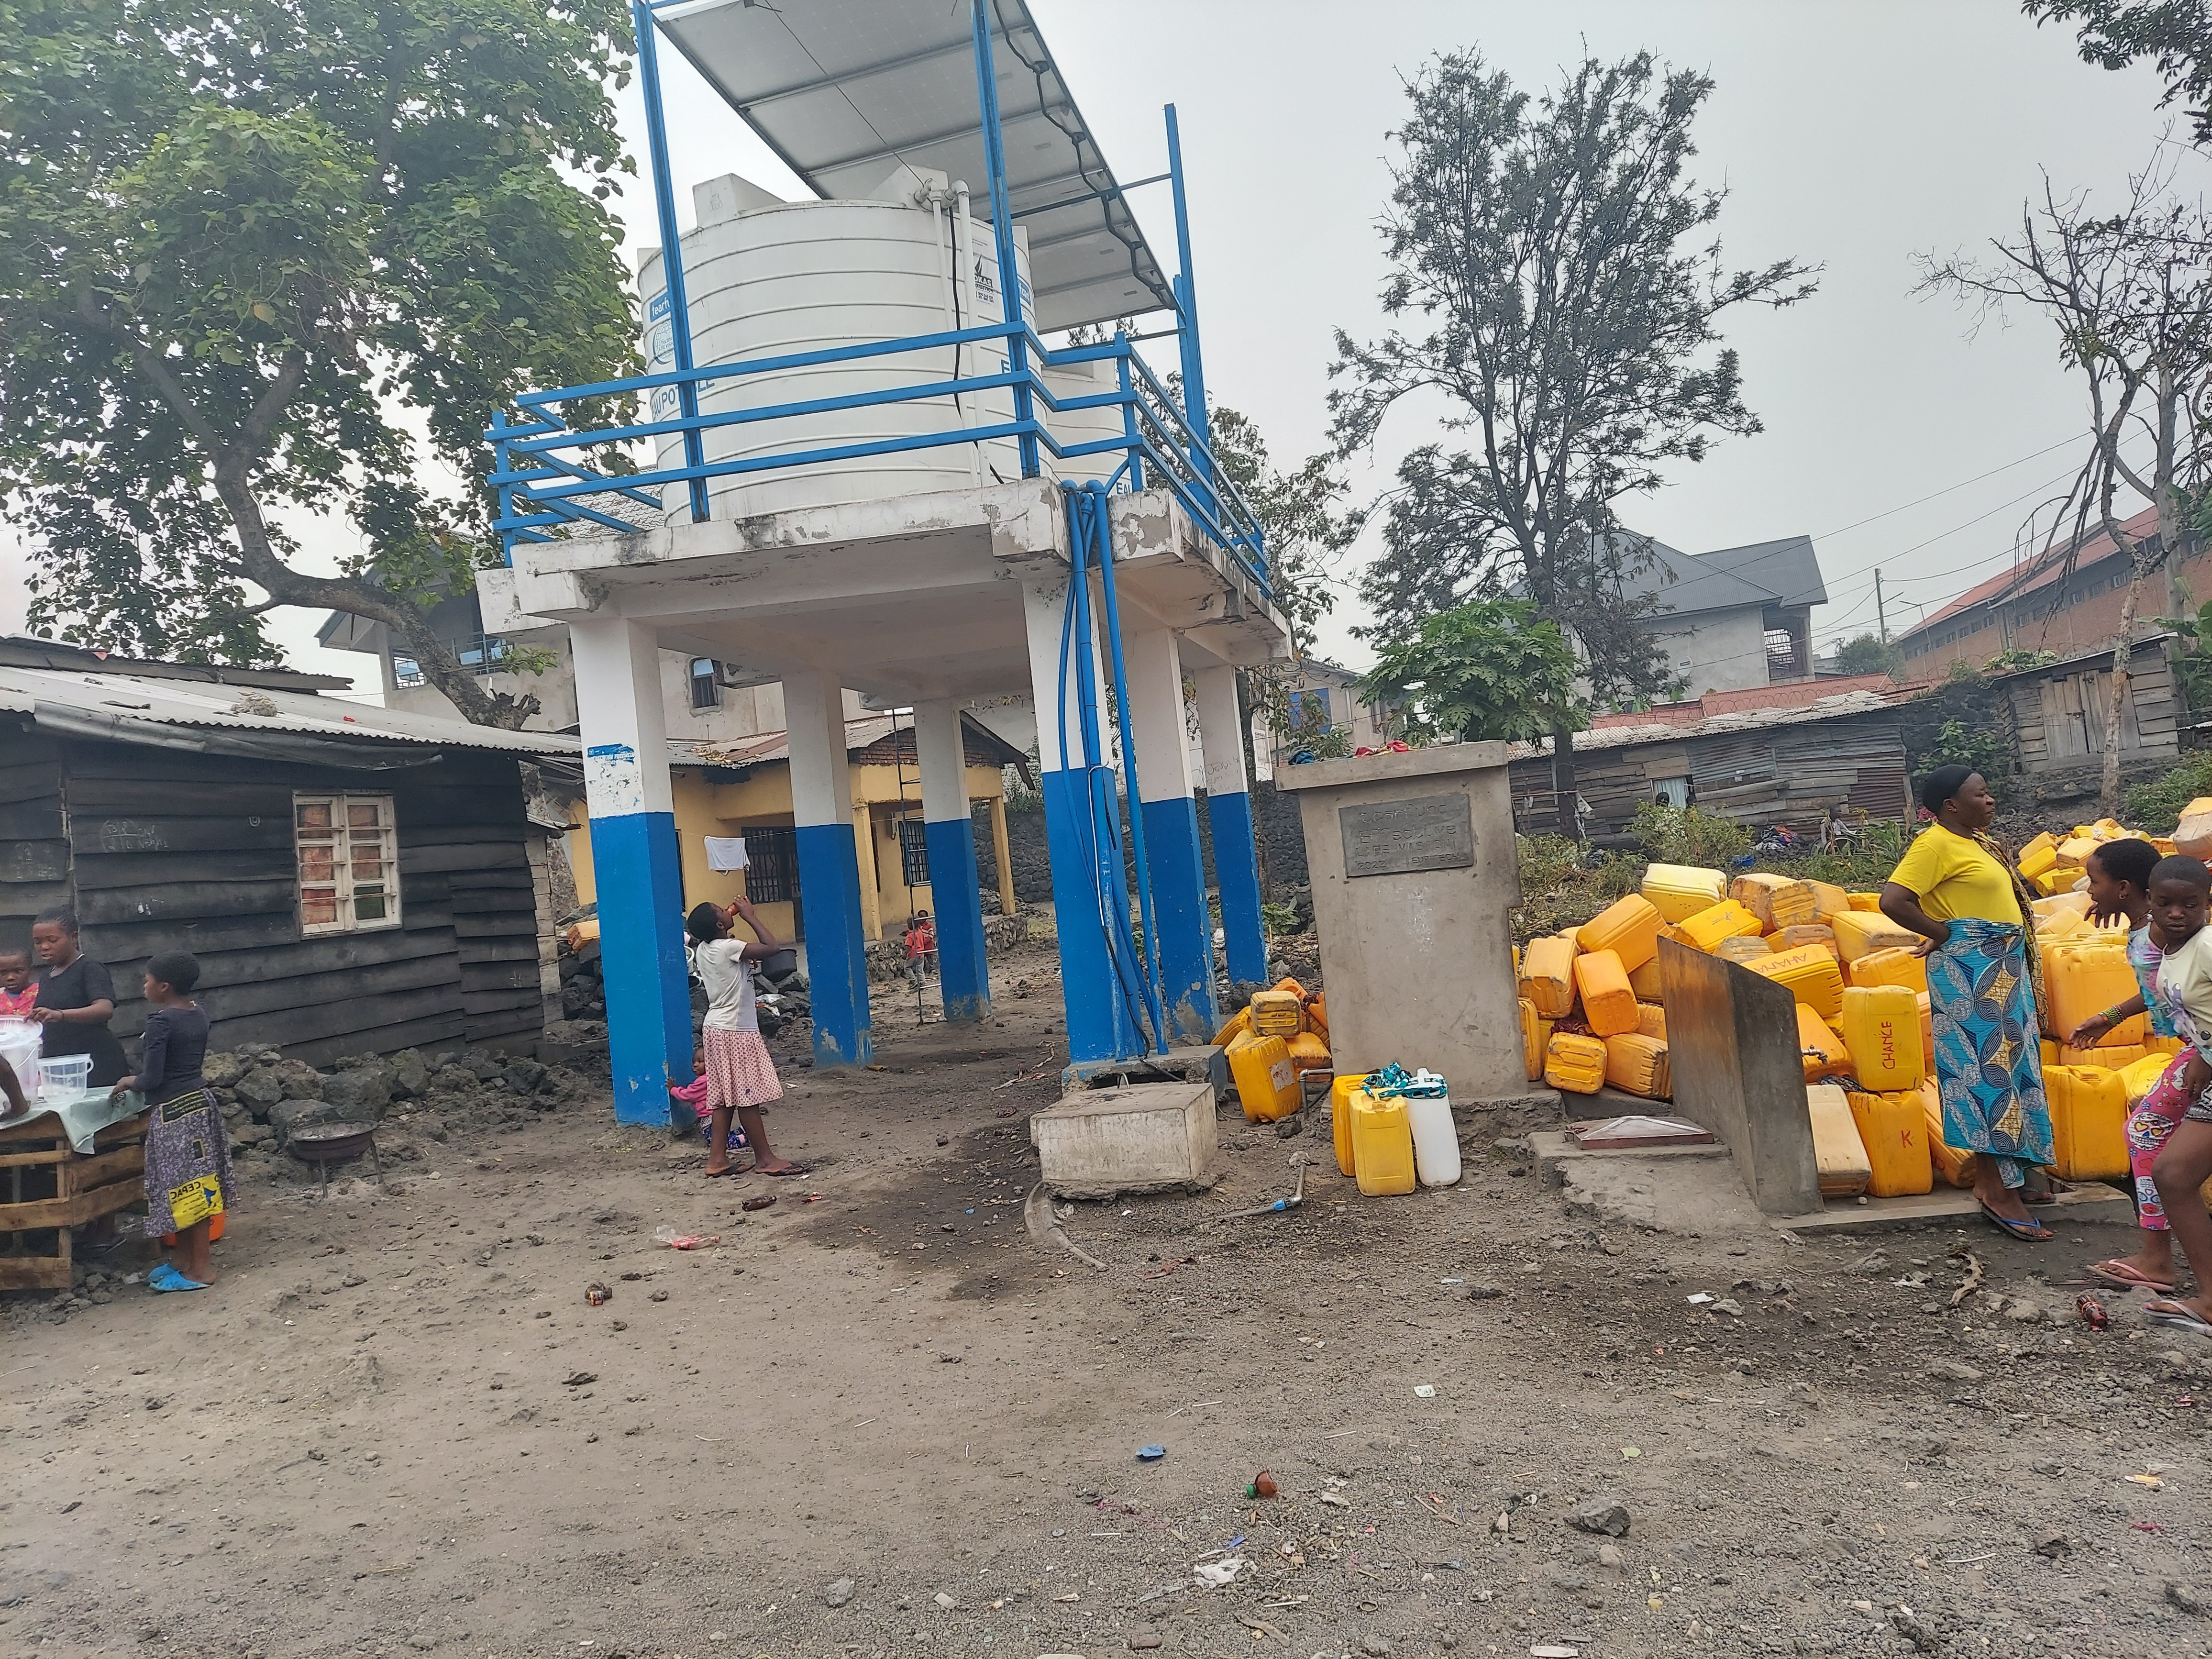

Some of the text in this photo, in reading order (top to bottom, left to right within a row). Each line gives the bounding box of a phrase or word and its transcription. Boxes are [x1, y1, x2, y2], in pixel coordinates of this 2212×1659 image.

[1357, 860, 1387, 871] 2022
[1881, 1021, 1896, 1069] CHANCE
[1901, 1130, 1913, 1148] K
